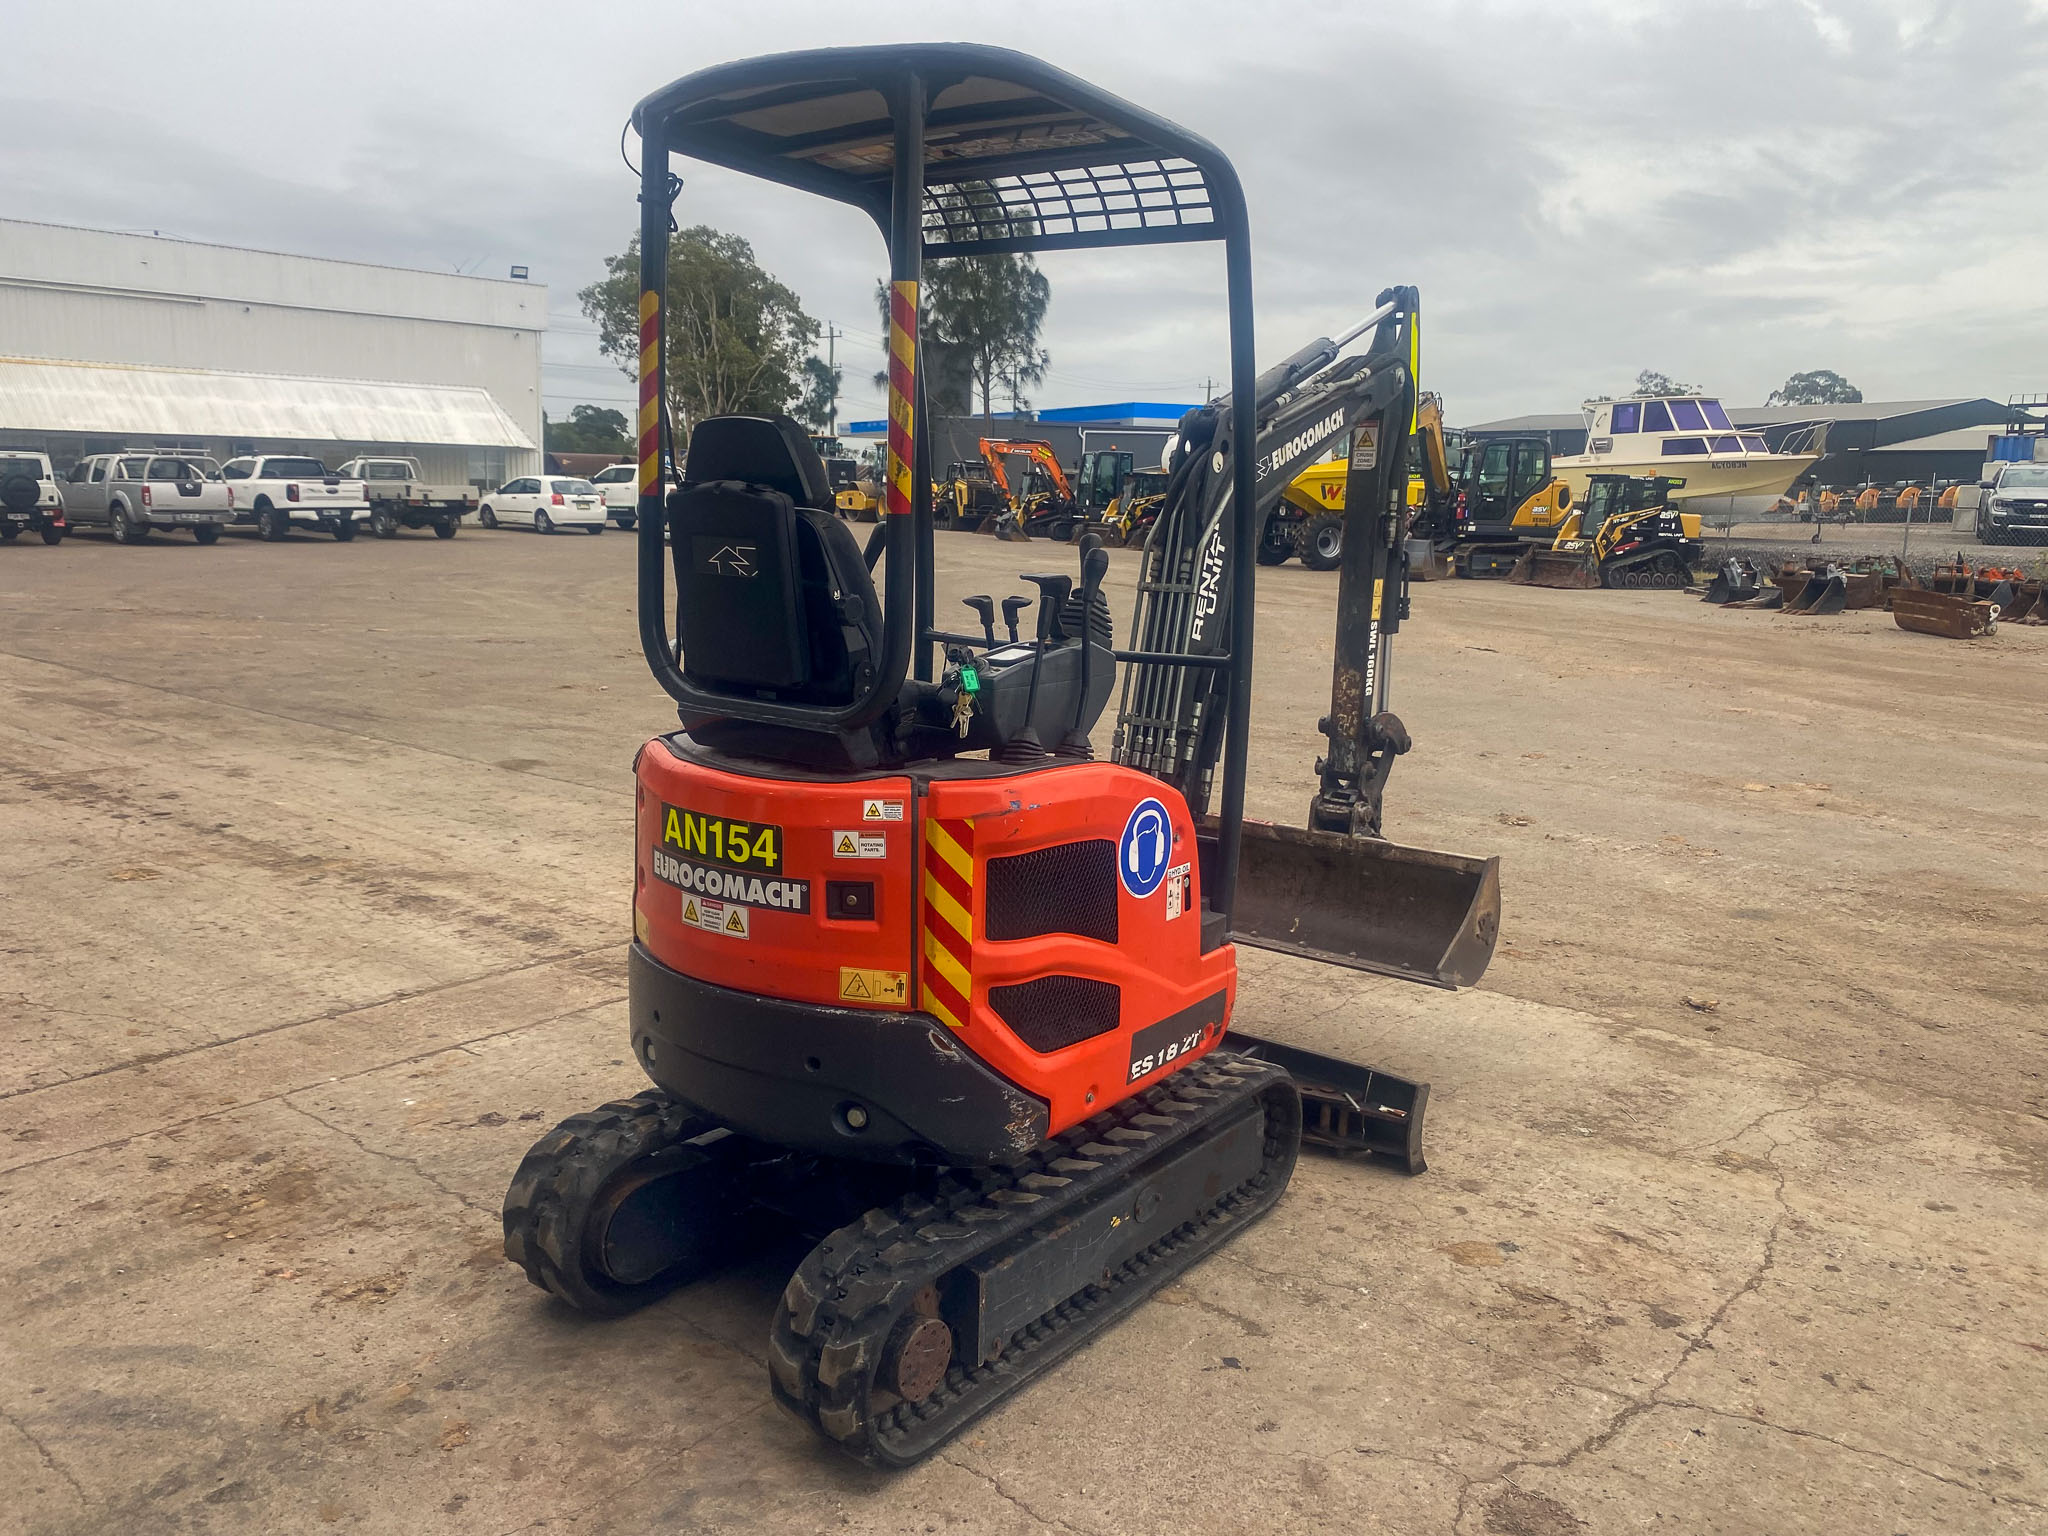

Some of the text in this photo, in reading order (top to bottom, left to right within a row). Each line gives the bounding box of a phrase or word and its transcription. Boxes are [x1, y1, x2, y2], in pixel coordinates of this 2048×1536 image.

[1271, 408, 1344, 471] EUROCOMACH
[1368, 621, 1378, 651] SWL
[664, 808, 778, 867] AN154
[653, 849, 802, 910] EUROCOMACH
[1131, 1054, 1154, 1080] ES
[1157, 1042, 1179, 1069] 18
